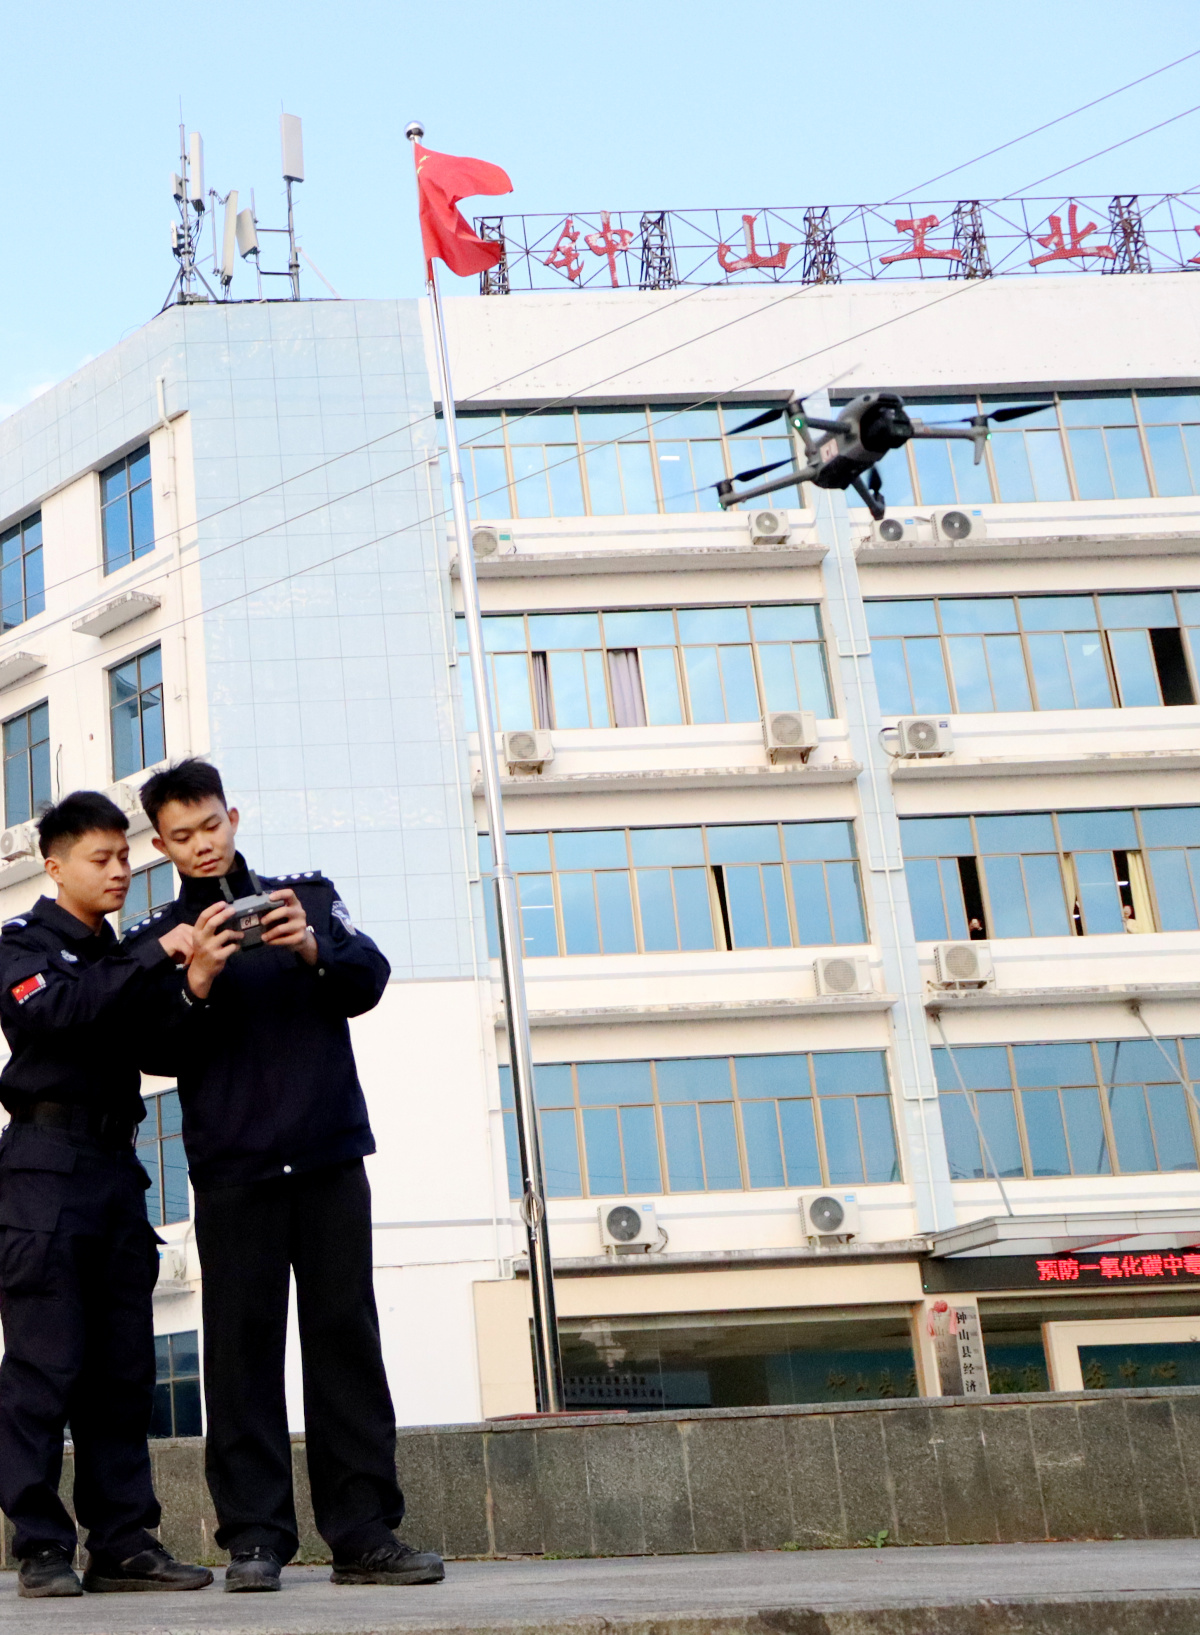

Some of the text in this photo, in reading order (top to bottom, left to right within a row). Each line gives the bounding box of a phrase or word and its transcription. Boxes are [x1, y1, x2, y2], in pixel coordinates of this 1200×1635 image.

[544, 203, 1200, 288] 钟山工业
[1036, 1252, 1200, 1281] 预防一氧化碳中毒
[956, 1311, 977, 1393] 钟山县经济
